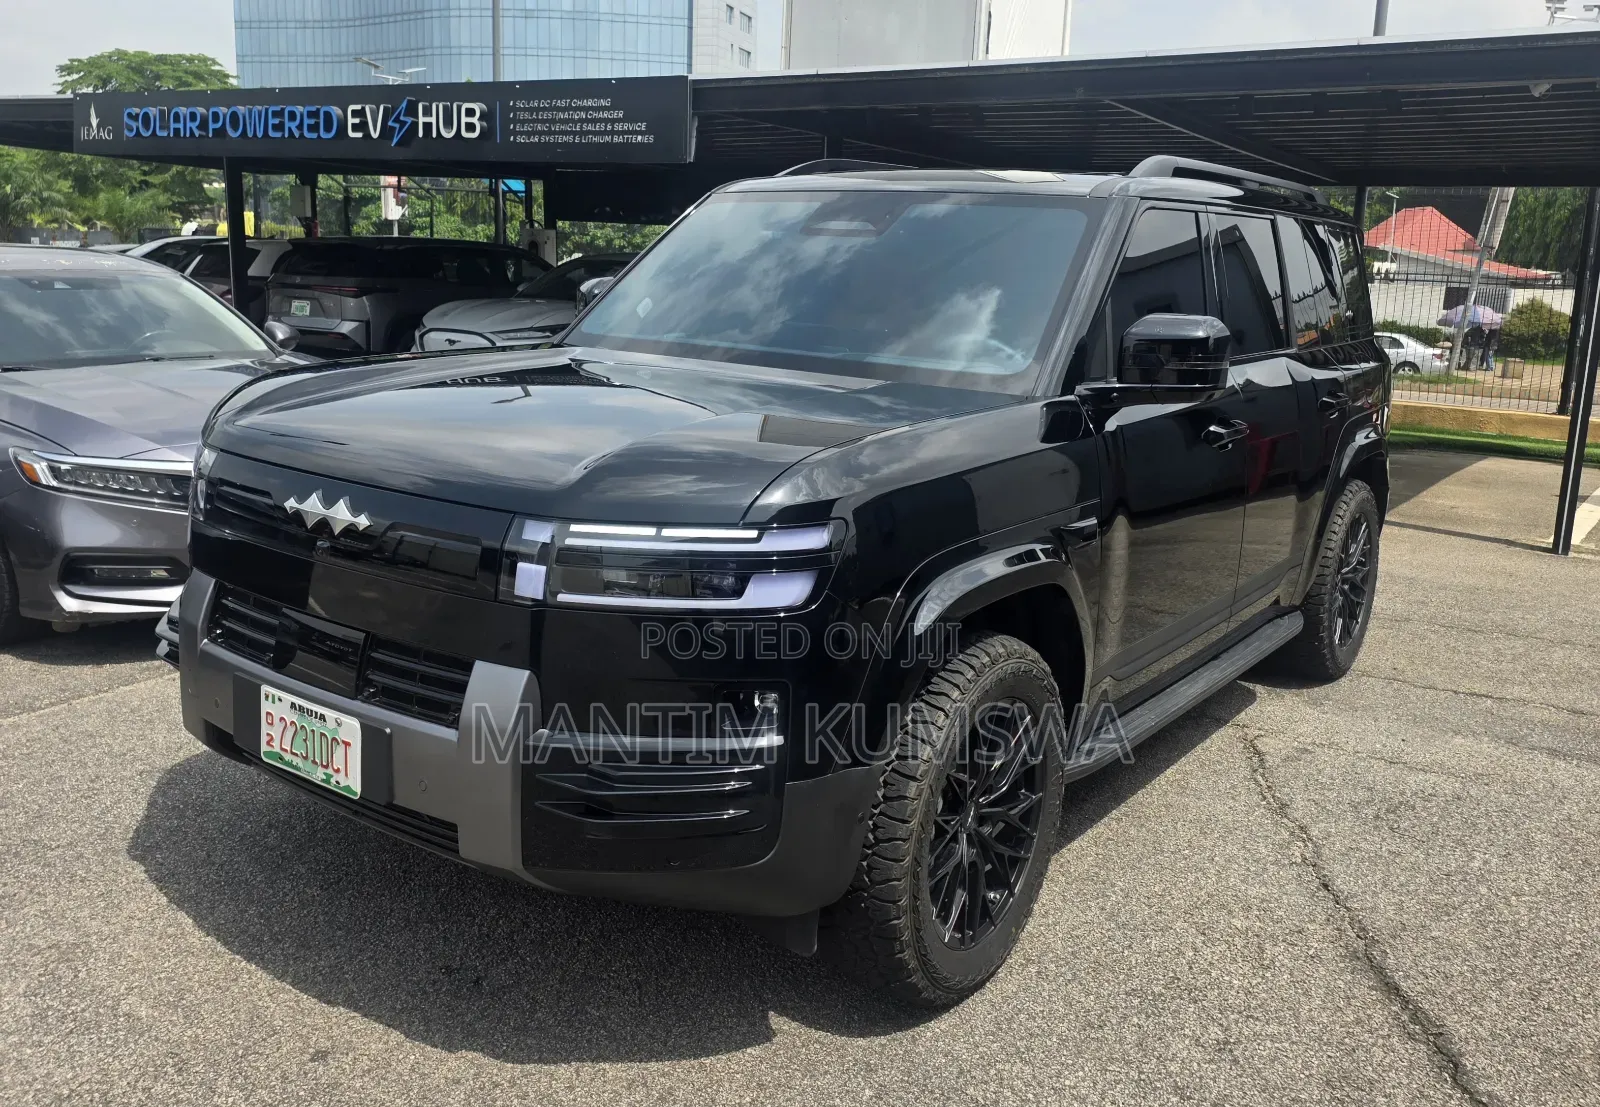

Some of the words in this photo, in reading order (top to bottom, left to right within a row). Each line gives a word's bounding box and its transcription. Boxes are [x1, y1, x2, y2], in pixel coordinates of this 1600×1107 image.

[515, 99, 539, 108] SOLAR
[540, 99, 551, 107] DC
[551, 99, 570, 107] FAST
[571, 98, 612, 107] CHARGING
[123, 105, 201, 138] SOLAR
[208, 105, 339, 139] POWERED
[347, 103, 387, 139] EV
[418, 102, 482, 139] HUB
[516, 111, 537, 119] TESLA
[538, 110, 587, 120] DESTINATION
[587, 110, 624, 119] CHARGER
[80, 125, 113, 141] JEMAG
[515, 123, 550, 131] ELECTRIC
[550, 123, 582, 131] VEHICLE
[582, 122, 606, 131] SALES
[606, 122, 613, 131] &
[613, 122, 647, 131] SERVICE
[515, 135, 540, 143] SOLAR
[540, 135, 574, 143] SYSTEMS
[574, 135, 581, 143] &
[581, 134, 612, 143] LITHIUM
[612, 134, 655, 143] BATTERIES
[289, 700, 328, 723] ABUJA
[278, 716, 352, 779] 2231DCT
